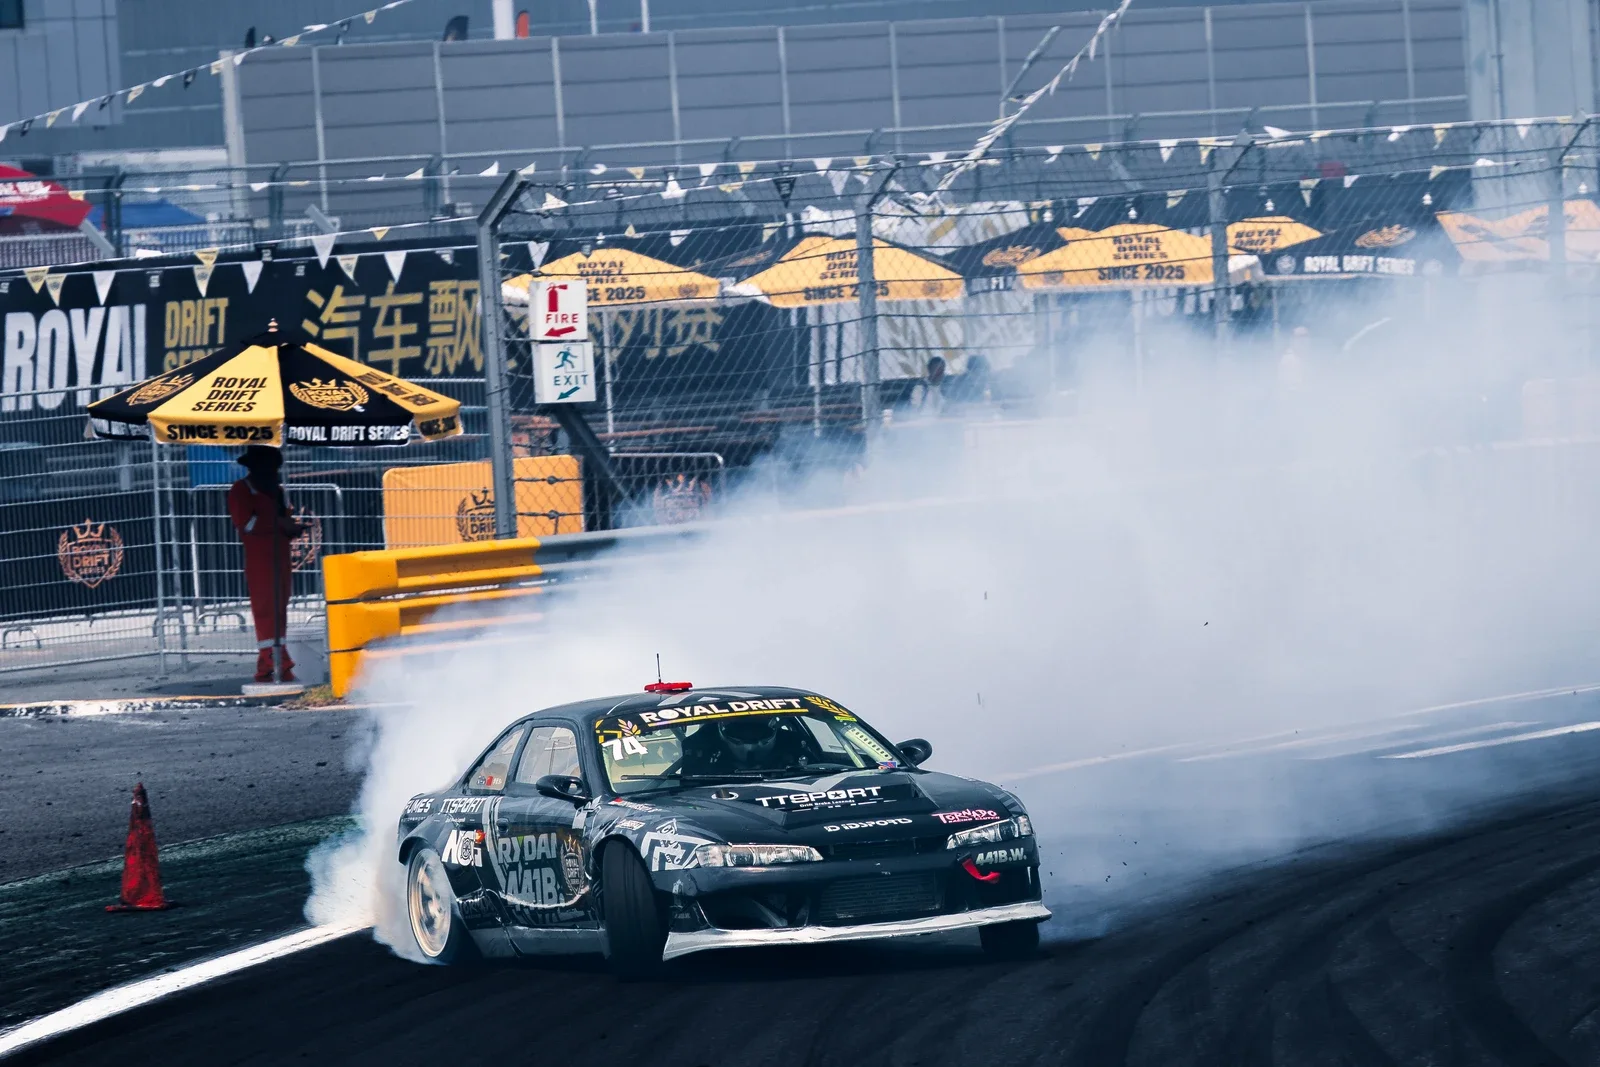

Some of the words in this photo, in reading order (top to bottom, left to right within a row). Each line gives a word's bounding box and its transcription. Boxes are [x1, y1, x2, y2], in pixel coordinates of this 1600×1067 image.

[1112, 236, 1162, 245] ROYAL
[1113, 251, 1168, 260] SERIES
[1098, 266, 1138, 281] SINCE
[1145, 264, 1186, 281] 2025
[1304, 256, 1341, 273] ROYAL
[605, 286, 646, 301] 2025
[164, 298, 229, 348] DRIFT
[545, 314, 579, 324] FIRE
[3, 304, 147, 412] ROYAL
[211, 377, 267, 389] ROYAL
[553, 374, 589, 386] EXIT
[206, 389, 260, 401] DRIFT
[191, 401, 257, 412] SERIES
[166, 425, 219, 440] SINCE
[223, 426, 274, 441] 2025
[288, 426, 328, 441] ROYAL
[331, 426, 366, 441] DRIFT
[368, 425, 411, 441] SERIES
[73, 553, 109, 567] DRIFT
[639, 701, 729, 723] ROYAL
[729, 698, 801, 713] DRIFT
[601, 735, 648, 761] 74
[755, 786, 881, 807] TTSPORT
[440, 797, 487, 815] TTSPORT
